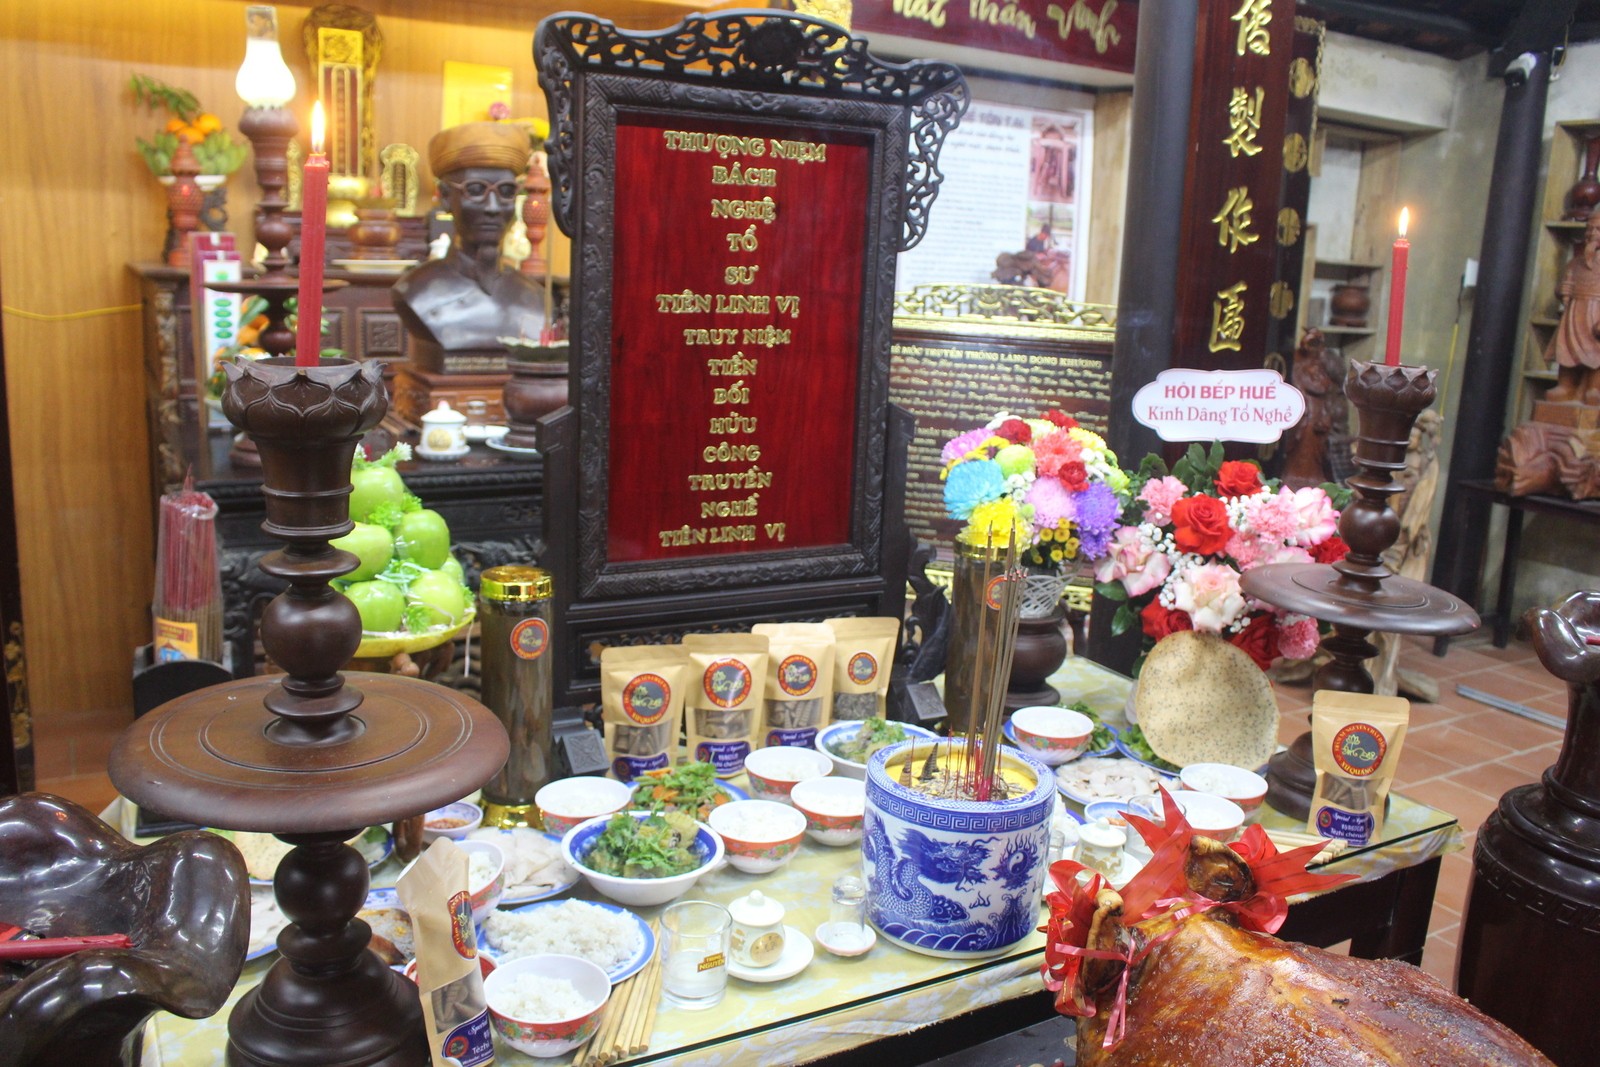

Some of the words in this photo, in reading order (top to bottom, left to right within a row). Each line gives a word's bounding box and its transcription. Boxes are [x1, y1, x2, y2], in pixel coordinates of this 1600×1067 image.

[663, 130, 766, 159] THƯỢNG
[769, 138, 827, 164] NIỆM
[711, 161, 777, 187] BÁCH
[711, 196, 776, 225] NGHỆ
[724, 264, 760, 285] SƯ
[655, 288, 711, 314] TIÊN
[715, 294, 770, 315] LINH
[775, 295, 800, 318] VỊ
[683, 328, 739, 346] TRUY
[742, 324, 791, 349] NIỆM
[713, 379, 750, 405] BỐI
[1200, 379, 1236, 399] BẾP
[1239, 379, 1277, 400] HUẾ
[709, 411, 758, 435] HỮU
[1148, 405, 1184, 421] Kính
[1187, 406, 1228, 425] Dâng
[703, 441, 761, 463] CÔNG
[688, 464, 773, 491] TRUYỀN
[700, 492, 760, 519] NGHỀ
[659, 524, 708, 547] TIÊN
[709, 524, 756, 544] LINH
[764, 522, 786, 543] VỊ
